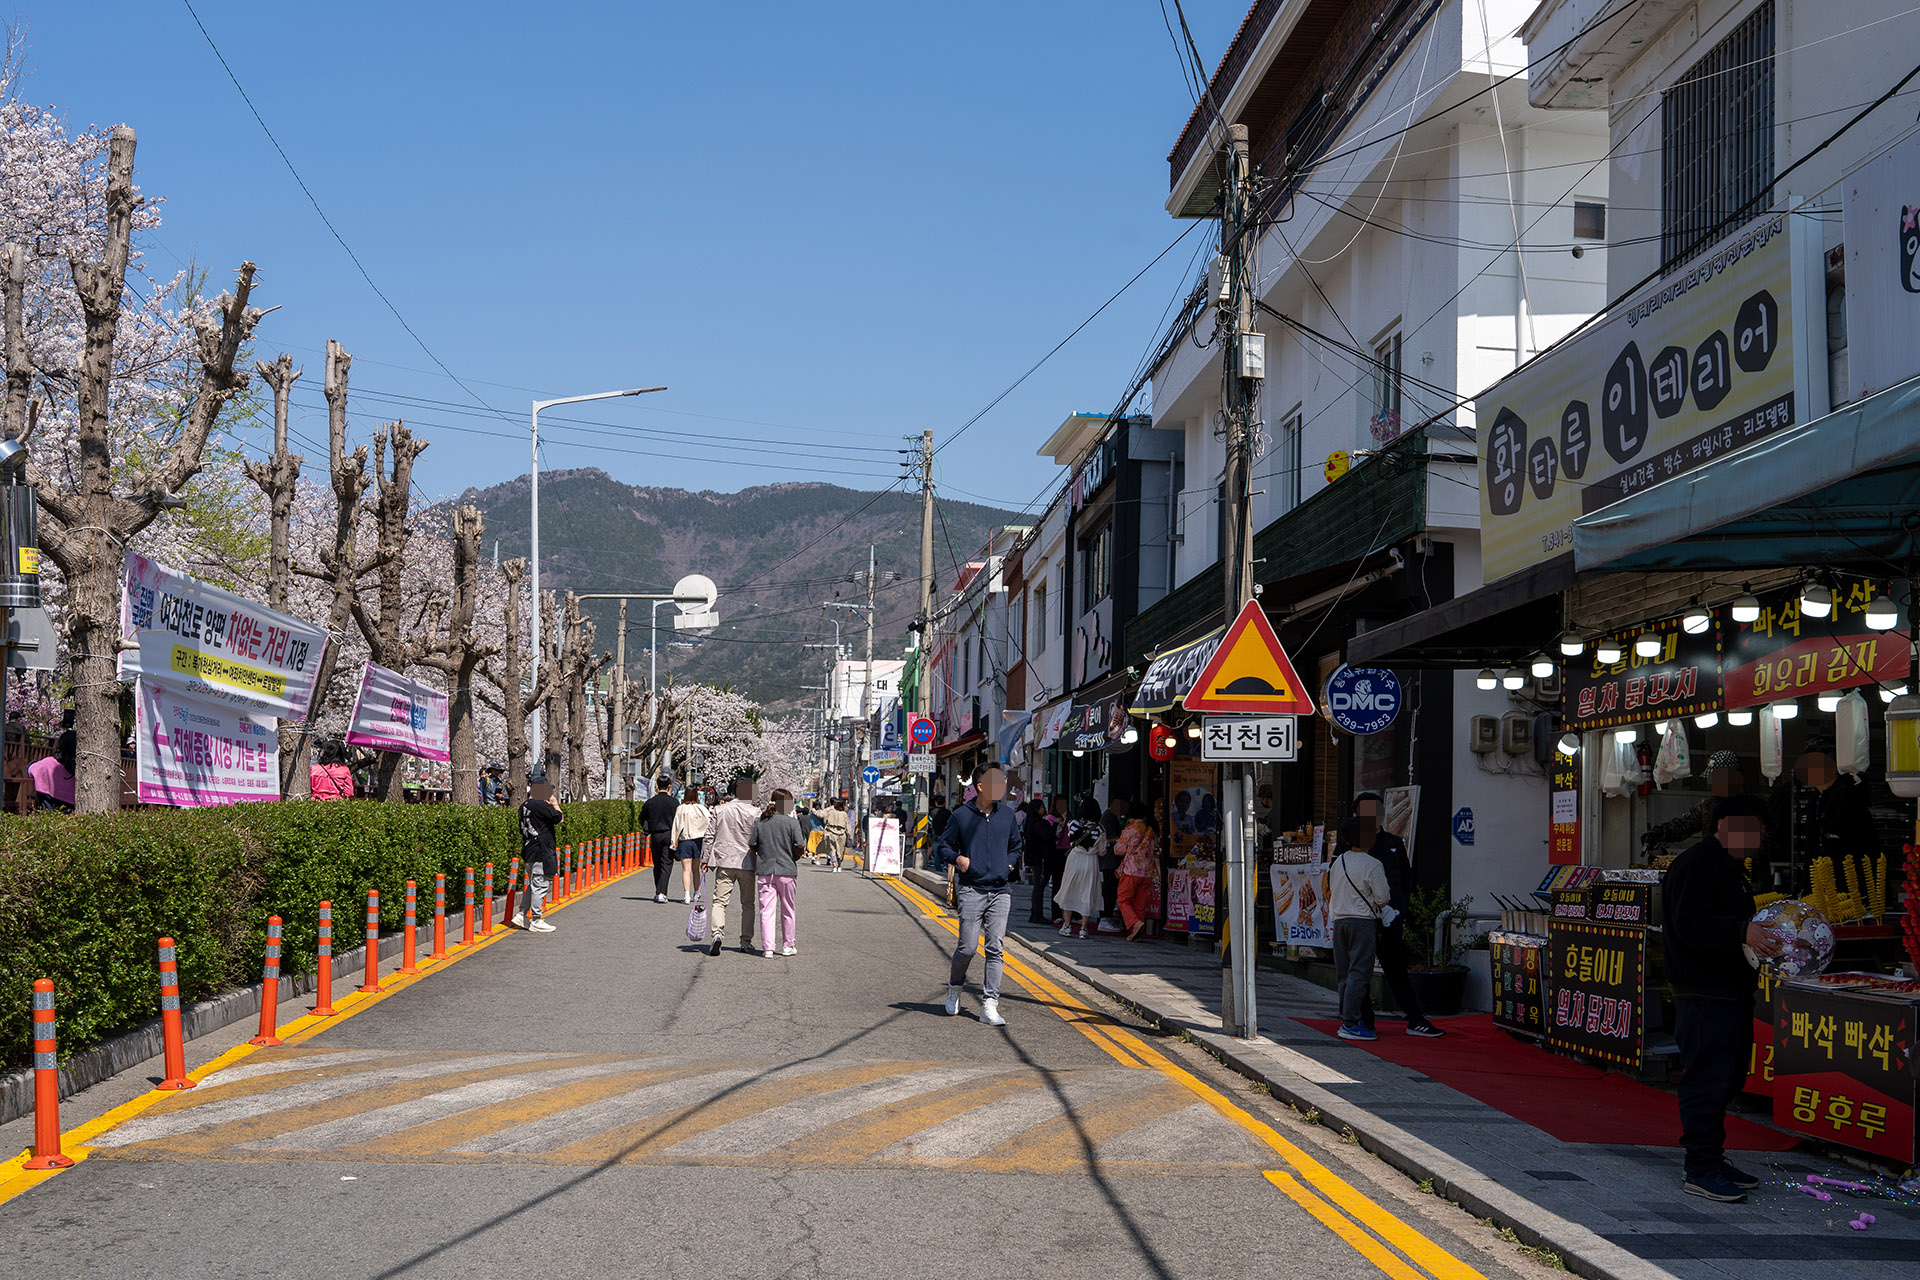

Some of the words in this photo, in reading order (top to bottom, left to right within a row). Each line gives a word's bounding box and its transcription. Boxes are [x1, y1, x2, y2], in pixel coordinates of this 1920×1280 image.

[1494, 410, 1590, 507] 황타루
[1608, 302, 1769, 452] 인테리어
[1619, 463, 1656, 494] 실내건축
[1663, 452, 1683, 476] 방수
[1692, 426, 1733, 460] 타일시공
[1743, 400, 1790, 436] 리모델링
[160, 592, 204, 640] 여좌천로
[204, 609, 228, 649] 양편
[225, 611, 264, 661] 차없는
[261, 626, 290, 668] 거리
[286, 639, 310, 672] 지정
[1753, 651, 1819, 697] 회오리
[1827, 639, 1879, 683] 감자
[1332, 692, 1396, 711] DMC
[1577, 686, 1620, 719] 열차
[1624, 666, 1699, 707] 닭꼬치
[884, 722, 894, 742] CU
[1207, 722, 1291, 753] 천천히
[1336, 712, 1391, 732] 299-7953
[174, 727, 233, 770] 진해중앙시장
[236, 740, 255, 772] 가는
[257, 743, 268, 773] 길
[1554, 773, 1575, 790] 빠삭
[1595, 903, 1614, 919] 열차
[1613, 905, 1641, 921] 닭꼬치
[1602, 888, 1636, 903] 호돌이네
[1564, 943, 1625, 986] 호돌이네
[1555, 987, 1586, 1029] 열차
[1585, 994, 1633, 1040] 닭꼬치
[1791, 1011, 1838, 1060] 빠삭
[1844, 1020, 1894, 1072] 빠삭
[1792, 1085, 1888, 1140] 탕후루
